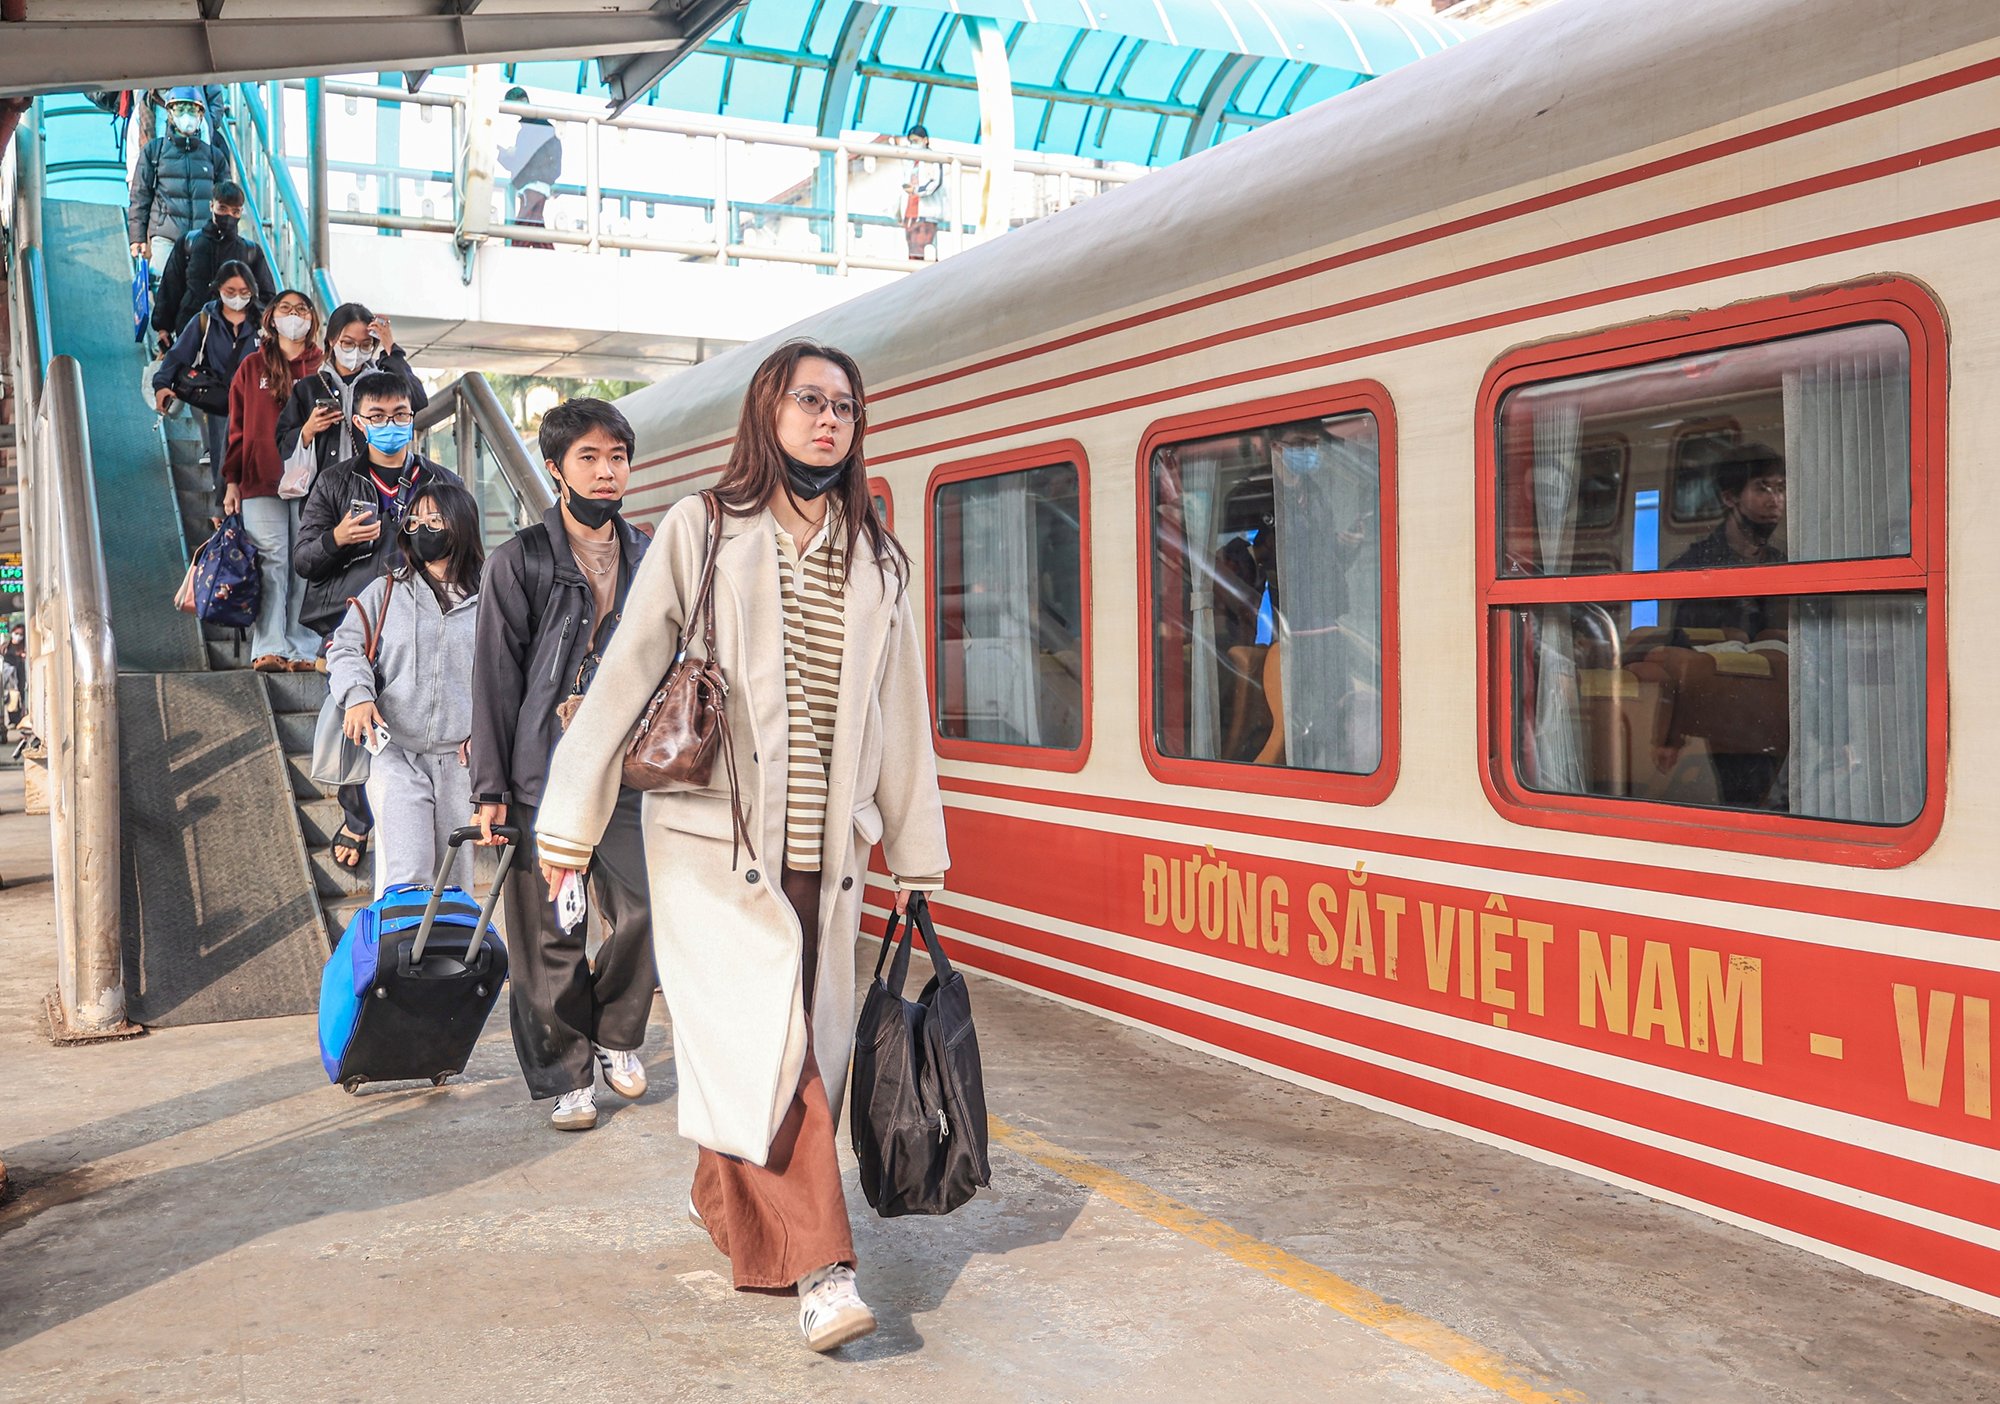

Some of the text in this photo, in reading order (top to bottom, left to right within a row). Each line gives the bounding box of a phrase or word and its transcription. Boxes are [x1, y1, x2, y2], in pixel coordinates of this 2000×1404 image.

[1143, 843, 1289, 957] ĐƯỜNG
[1307, 860, 1406, 981] SẮT
[1419, 892, 1554, 1029] VIỆT
[1579, 928, 1763, 1066] NAM
[1809, 1032, 1844, 1060] -
